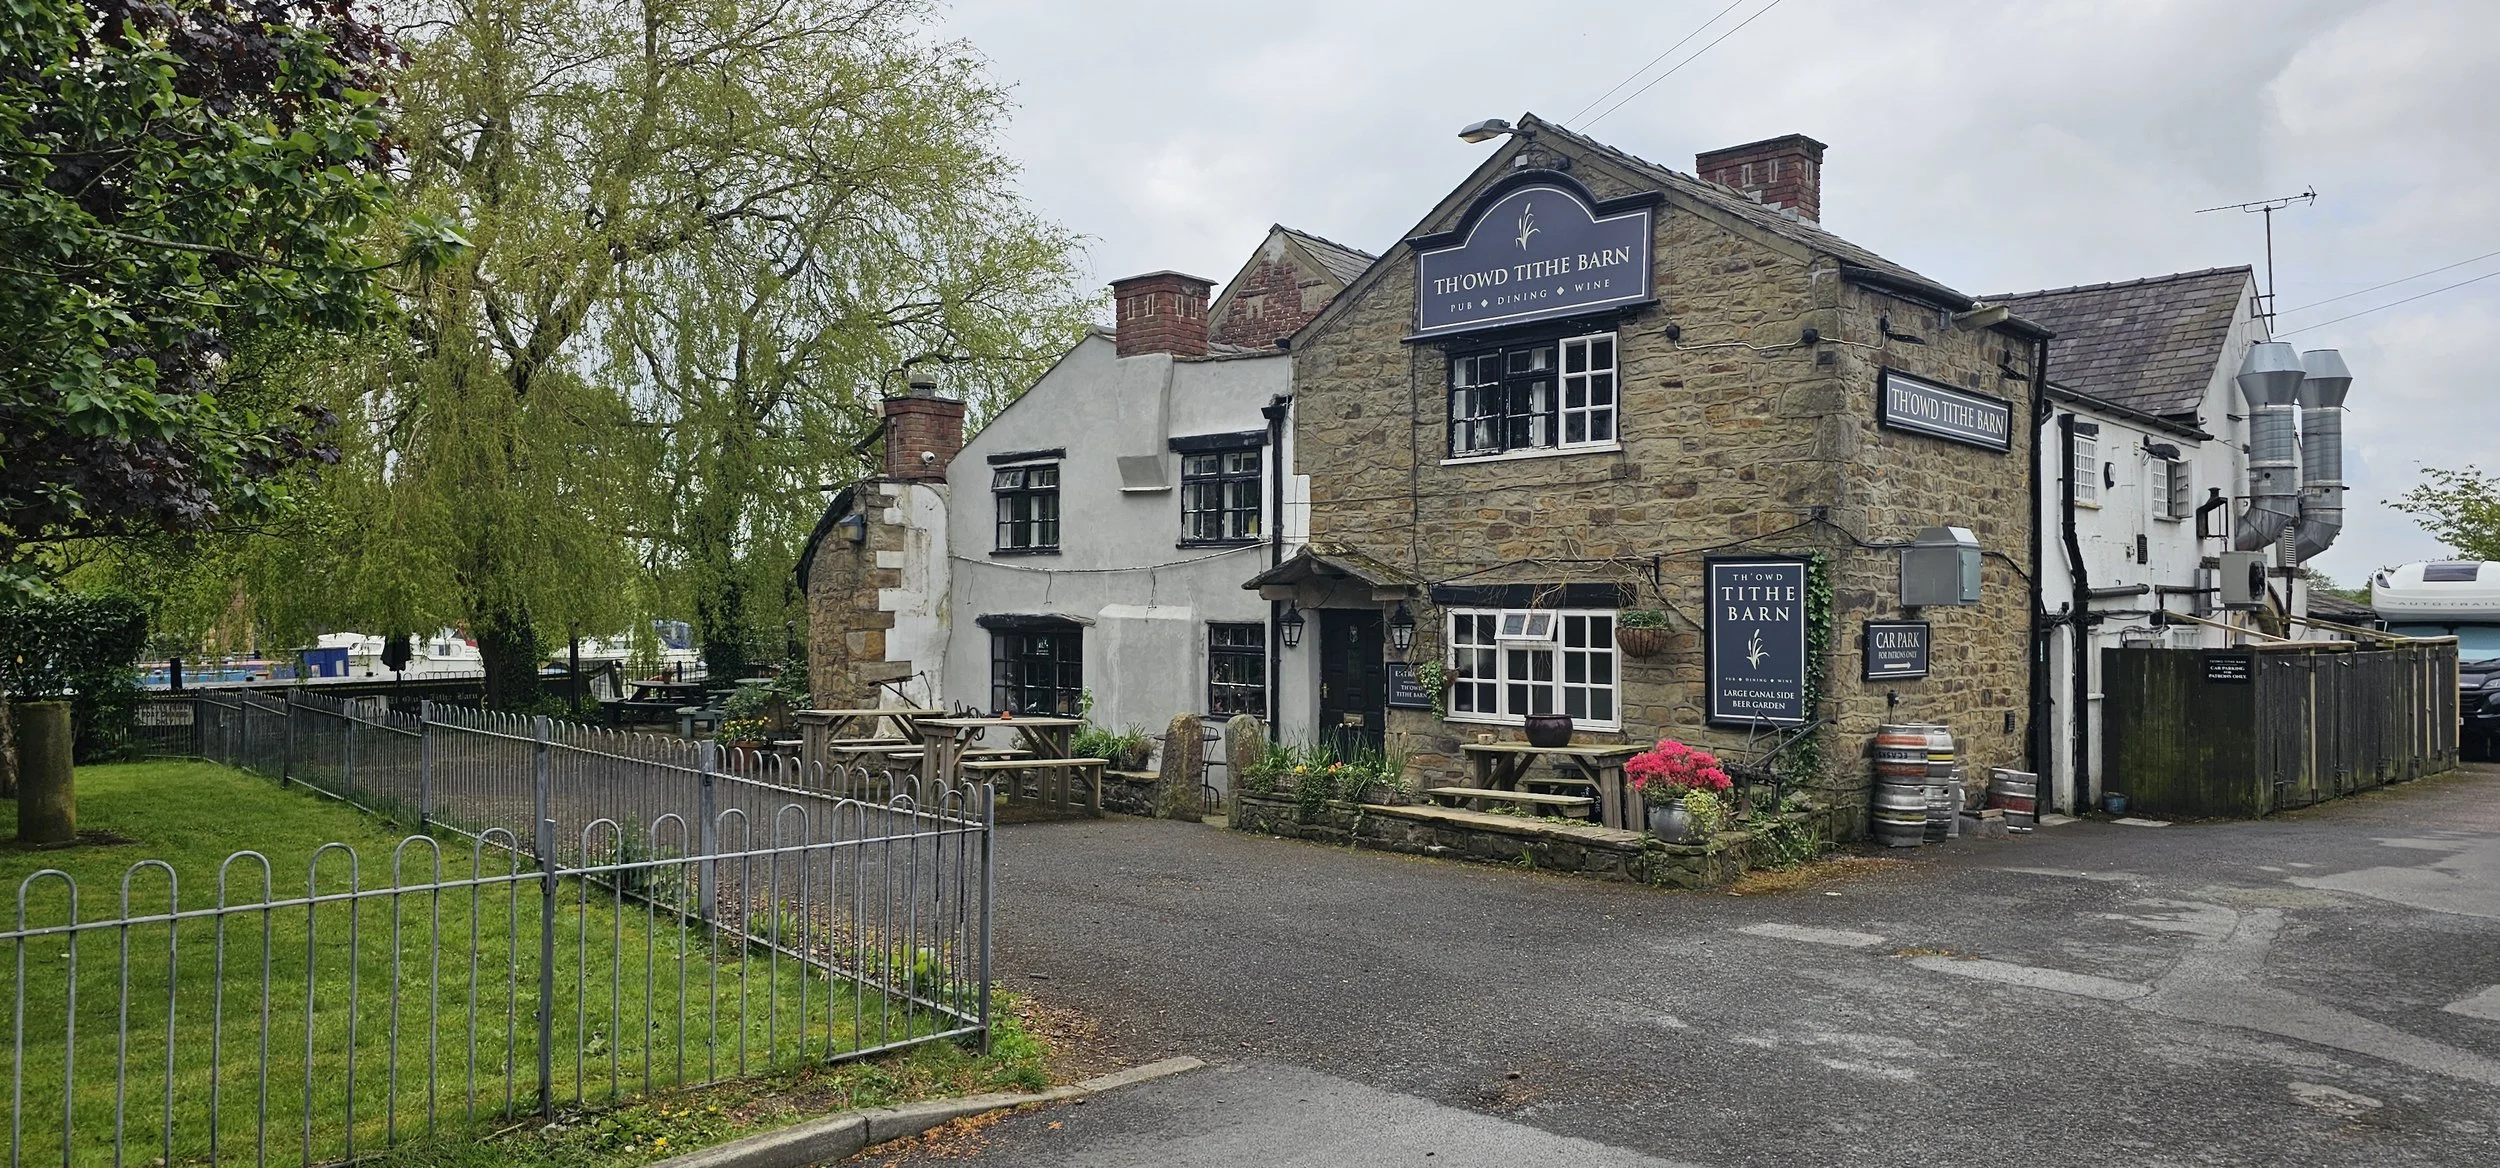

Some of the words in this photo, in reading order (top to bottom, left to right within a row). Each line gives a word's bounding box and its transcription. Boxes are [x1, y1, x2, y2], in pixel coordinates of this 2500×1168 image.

[1434, 268, 1509, 296] TH'OWD
[1514, 256, 1570, 282] TITHE
[1577, 246, 1630, 272] BARN
[1450, 301, 1473, 313] PUB
[1497, 289, 1547, 305] DINING
[1574, 278, 1610, 293] WINE
[1892, 388, 1939, 420] TH'OWD
[1942, 401, 1974, 428] TITHE
[1977, 409, 2004, 434] BARN
[1733, 573, 1783, 581] TH'OWD
[1722, 586, 1795, 601] TITHE
[1728, 606, 1790, 622] BARN
[1876, 632, 1896, 649] CAR
[1897, 632, 1920, 648] PARK
[1878, 651, 1887, 659] FOR
[1888, 651, 1905, 659] PATRONS
[1723, 689, 1748, 698] LARGE
[1749, 690, 1775, 699] CANAL
[1776, 691, 1795, 700] SIDE
[1732, 700, 1751, 708] BEER
[1752, 701, 1786, 710] GARDEN
